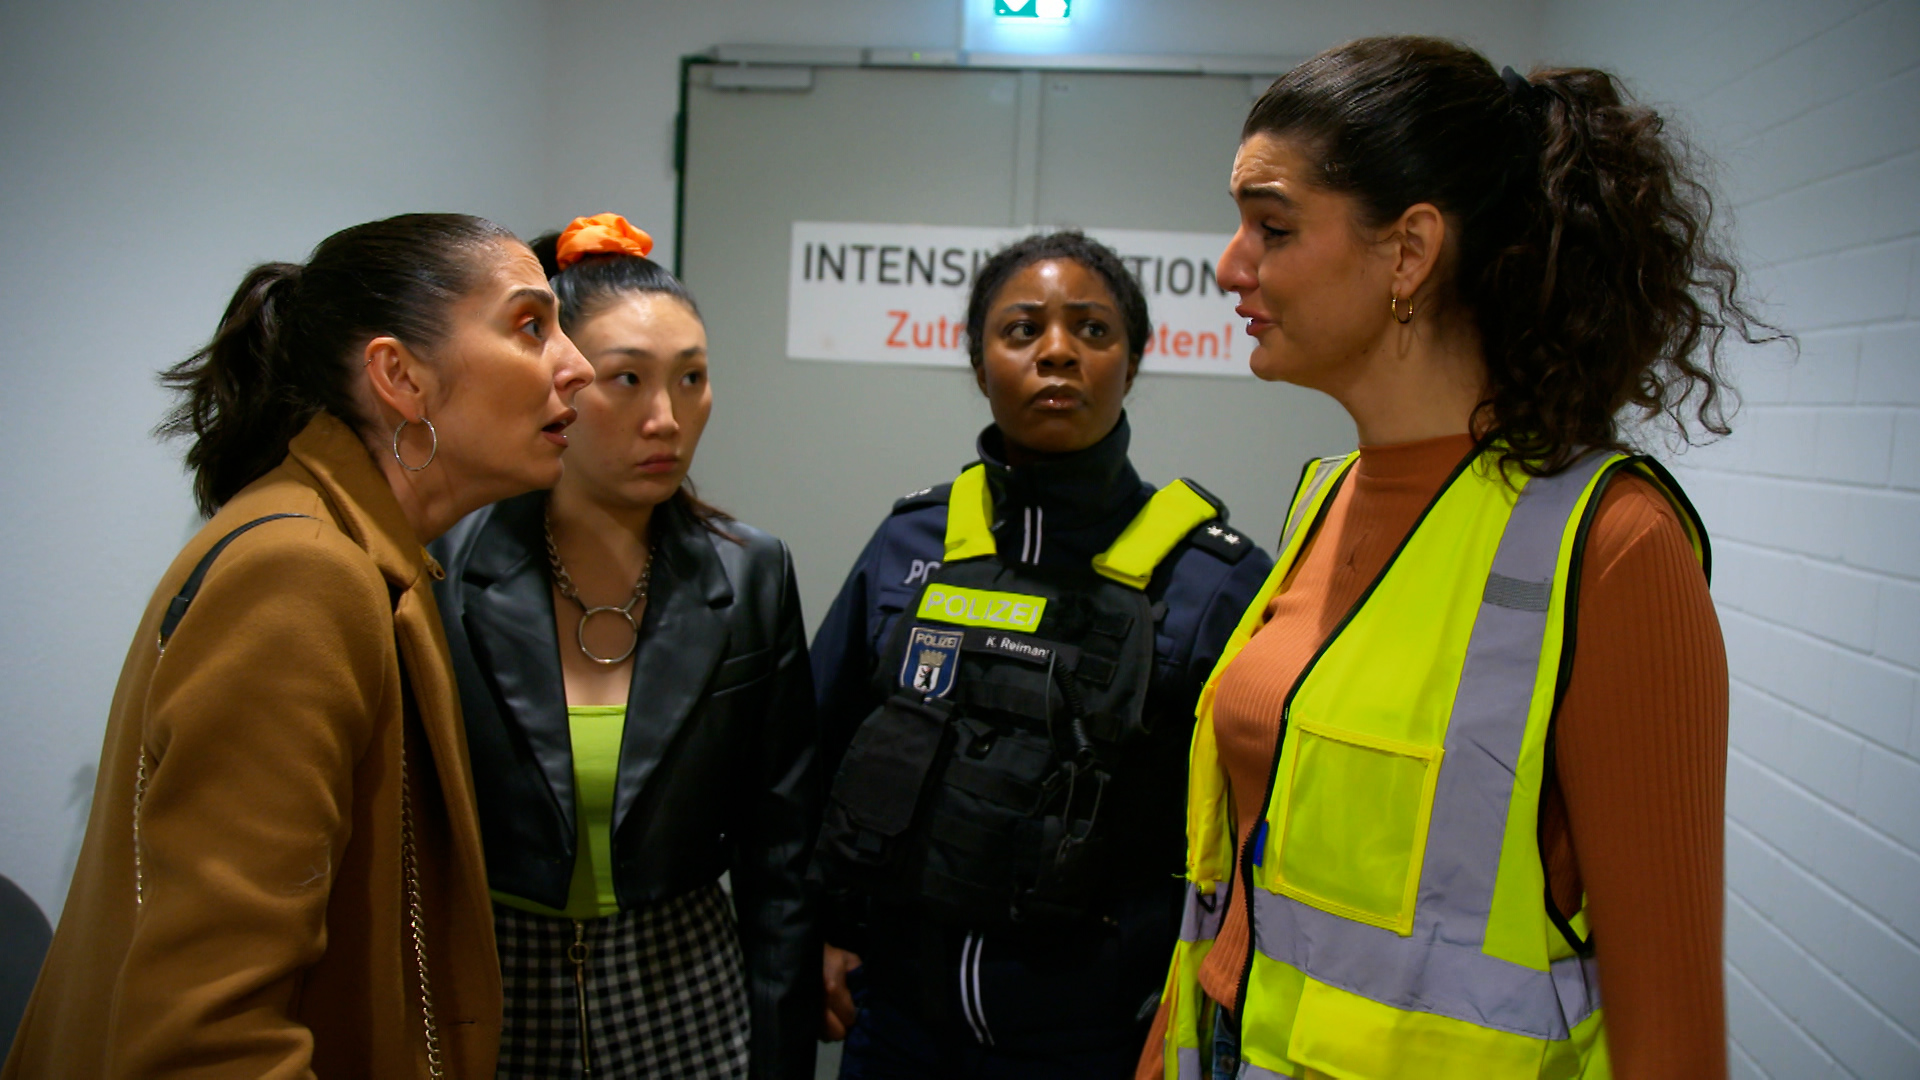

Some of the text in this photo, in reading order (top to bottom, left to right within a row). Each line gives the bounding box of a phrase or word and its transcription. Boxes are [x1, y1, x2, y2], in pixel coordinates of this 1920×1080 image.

[803, 243, 1229, 297] INTENSITION
[886, 310, 966, 349] Zutr
[925, 592, 1039, 625] POLIZEI
[916, 634, 957, 648] POLIZEI
[1000, 637, 1050, 658] Reiman
